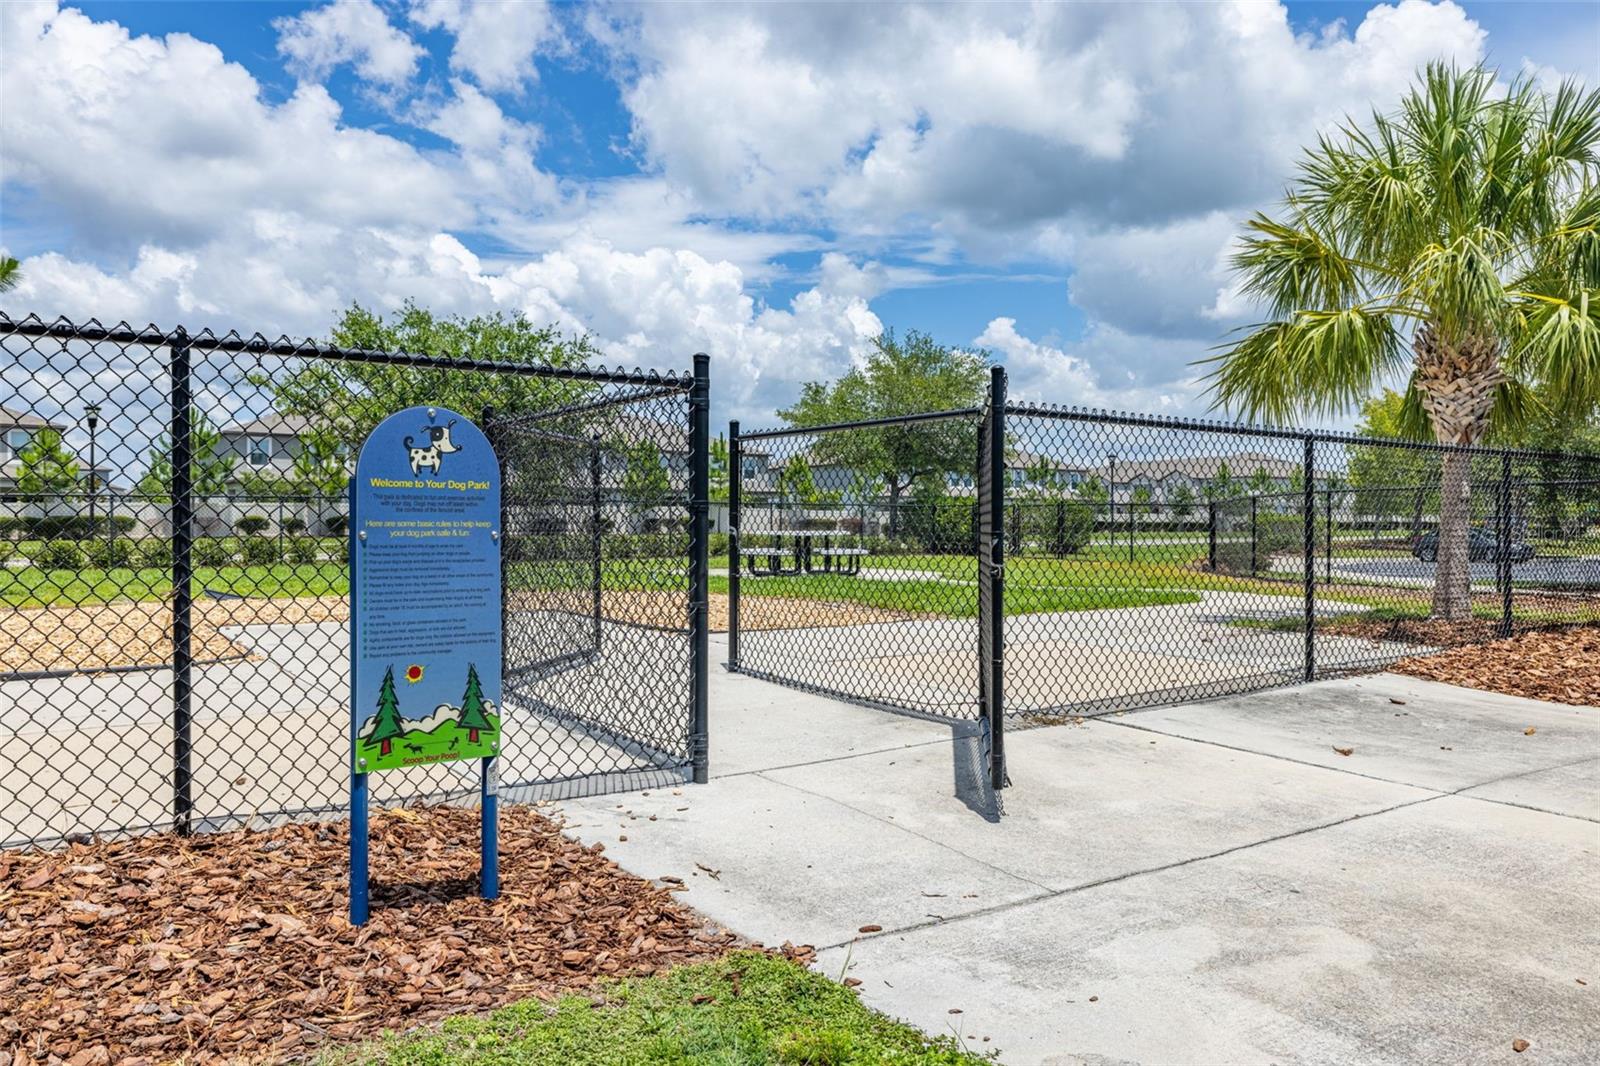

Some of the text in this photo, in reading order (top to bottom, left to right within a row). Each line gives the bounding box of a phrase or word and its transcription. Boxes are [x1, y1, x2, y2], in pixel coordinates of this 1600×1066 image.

[370, 478, 490, 491] Welcome to Your Dog Park!
[460, 521, 475, 529] help
[475, 521, 492, 529] keep
[390, 530, 406, 538] your
[407, 529, 420, 538] dog
[420, 530, 435, 538] park
[435, 529, 450, 537] safe
[402, 757, 424, 765] Scoop
[440, 751, 461, 760] Poop!
